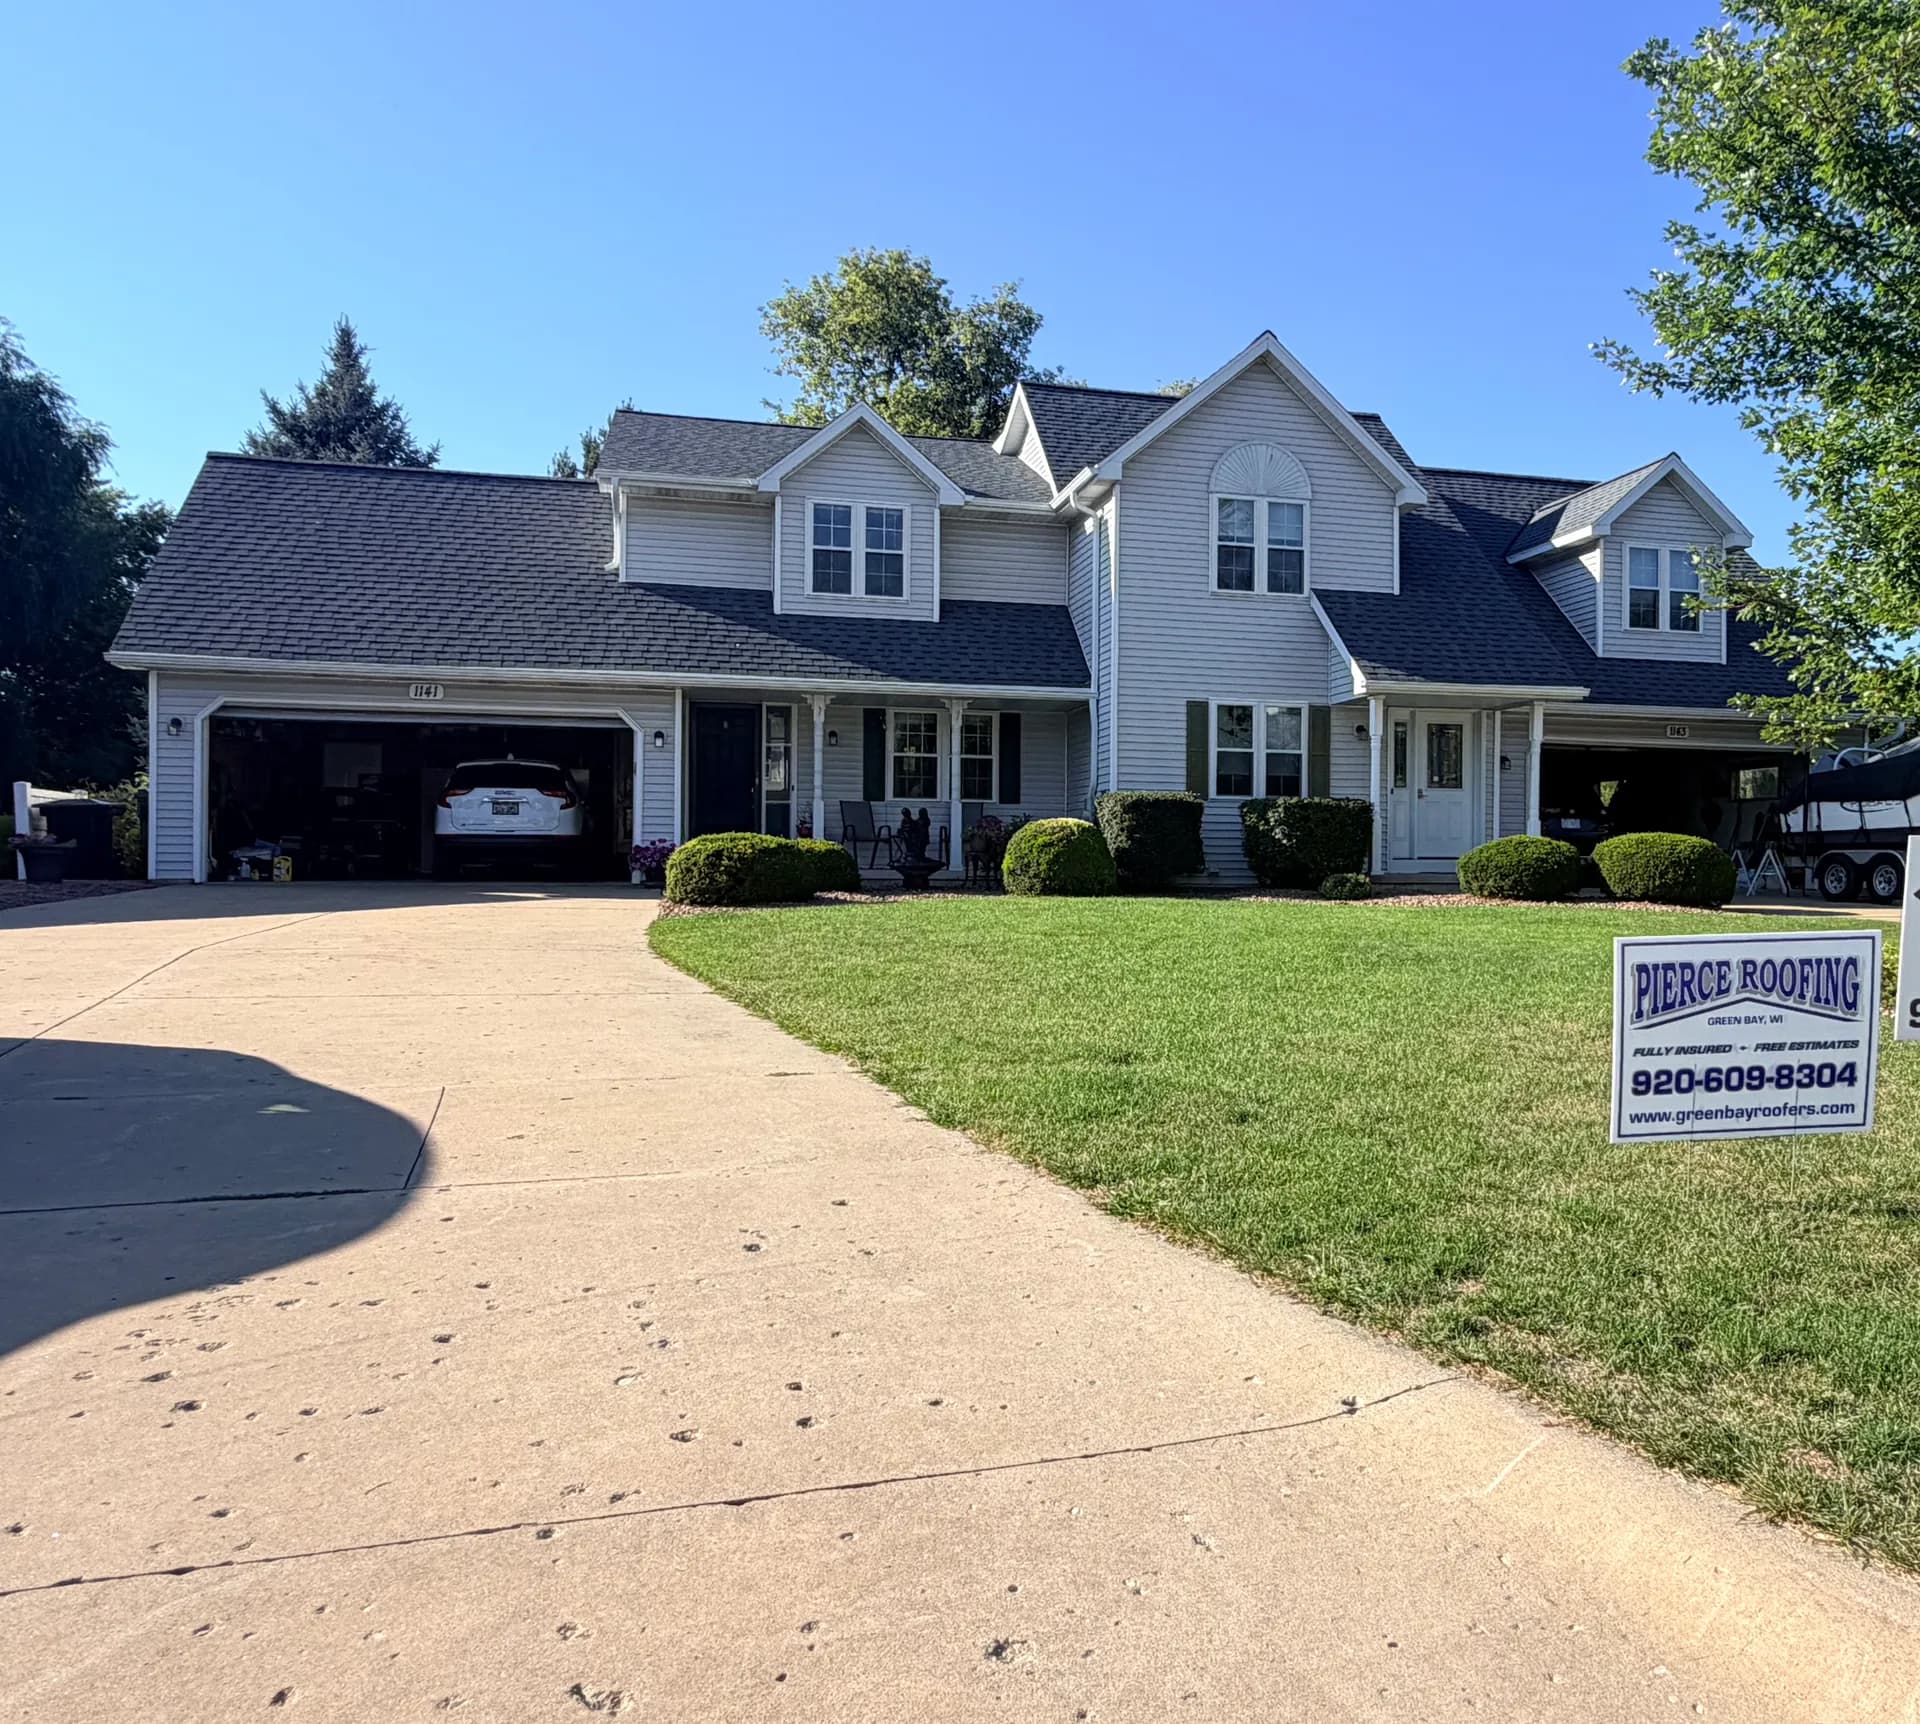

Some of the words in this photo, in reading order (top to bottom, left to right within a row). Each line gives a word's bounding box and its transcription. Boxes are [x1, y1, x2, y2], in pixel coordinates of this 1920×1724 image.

[414, 685, 438, 697] 1141
[1632, 959, 1732, 1022] PIERCE
[1740, 957, 1860, 1013] ROOFING
[1707, 1016, 1742, 1026] GREEN
[1744, 1015, 1768, 1025] BAY,
[1769, 1014, 1784, 1024] WI
[1633, 1046, 1673, 1057] FULLY
[1675, 1044, 1732, 1056] INSURED
[1753, 1042, 1786, 1053] FREE
[1788, 1039, 1860, 1052] ESTIMATES
[1631, 1062, 1858, 1096] 920-609-8304
[1629, 1103, 1856, 1125] www.greenbayroofers.com
